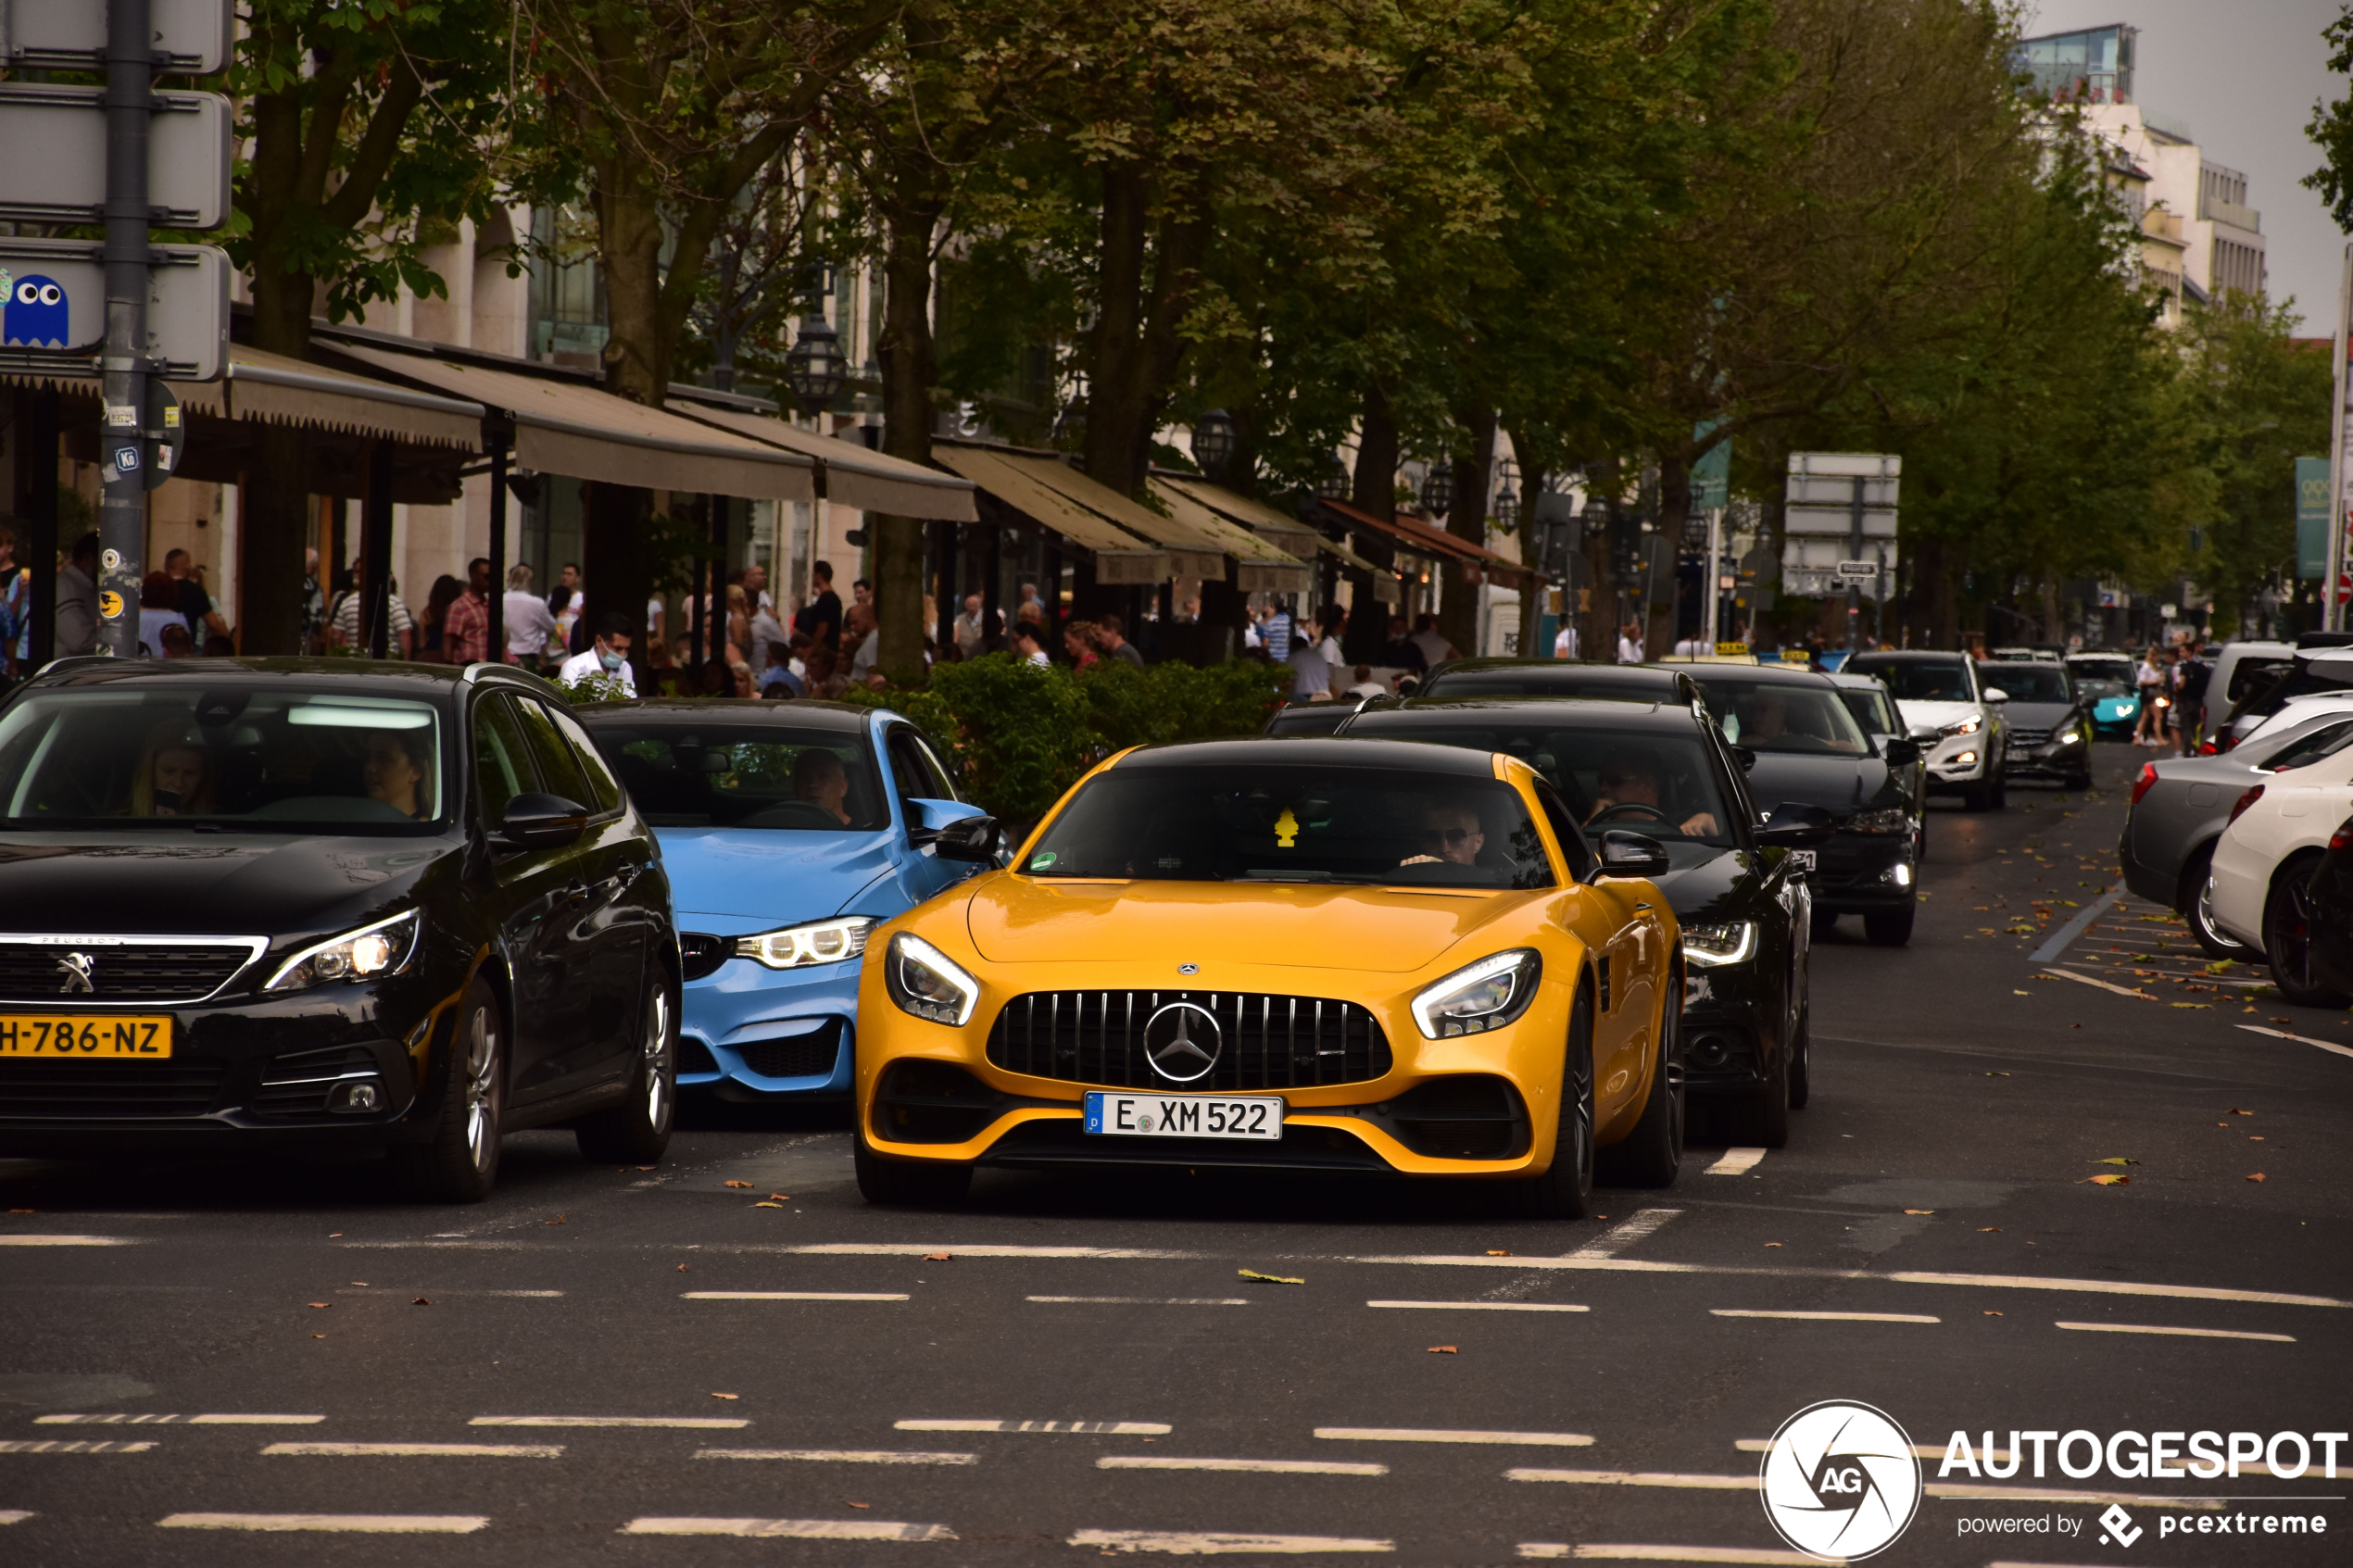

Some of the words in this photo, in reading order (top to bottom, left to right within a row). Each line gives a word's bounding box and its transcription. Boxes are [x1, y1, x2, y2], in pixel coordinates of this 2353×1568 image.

[121, 451, 135, 467] Kö
[1090, 1118, 1099, 1127] D
[1116, 1099, 1136, 1130] E
[1159, 1100, 1200, 1132] XM
[1207, 1102, 1267, 1135] 522
